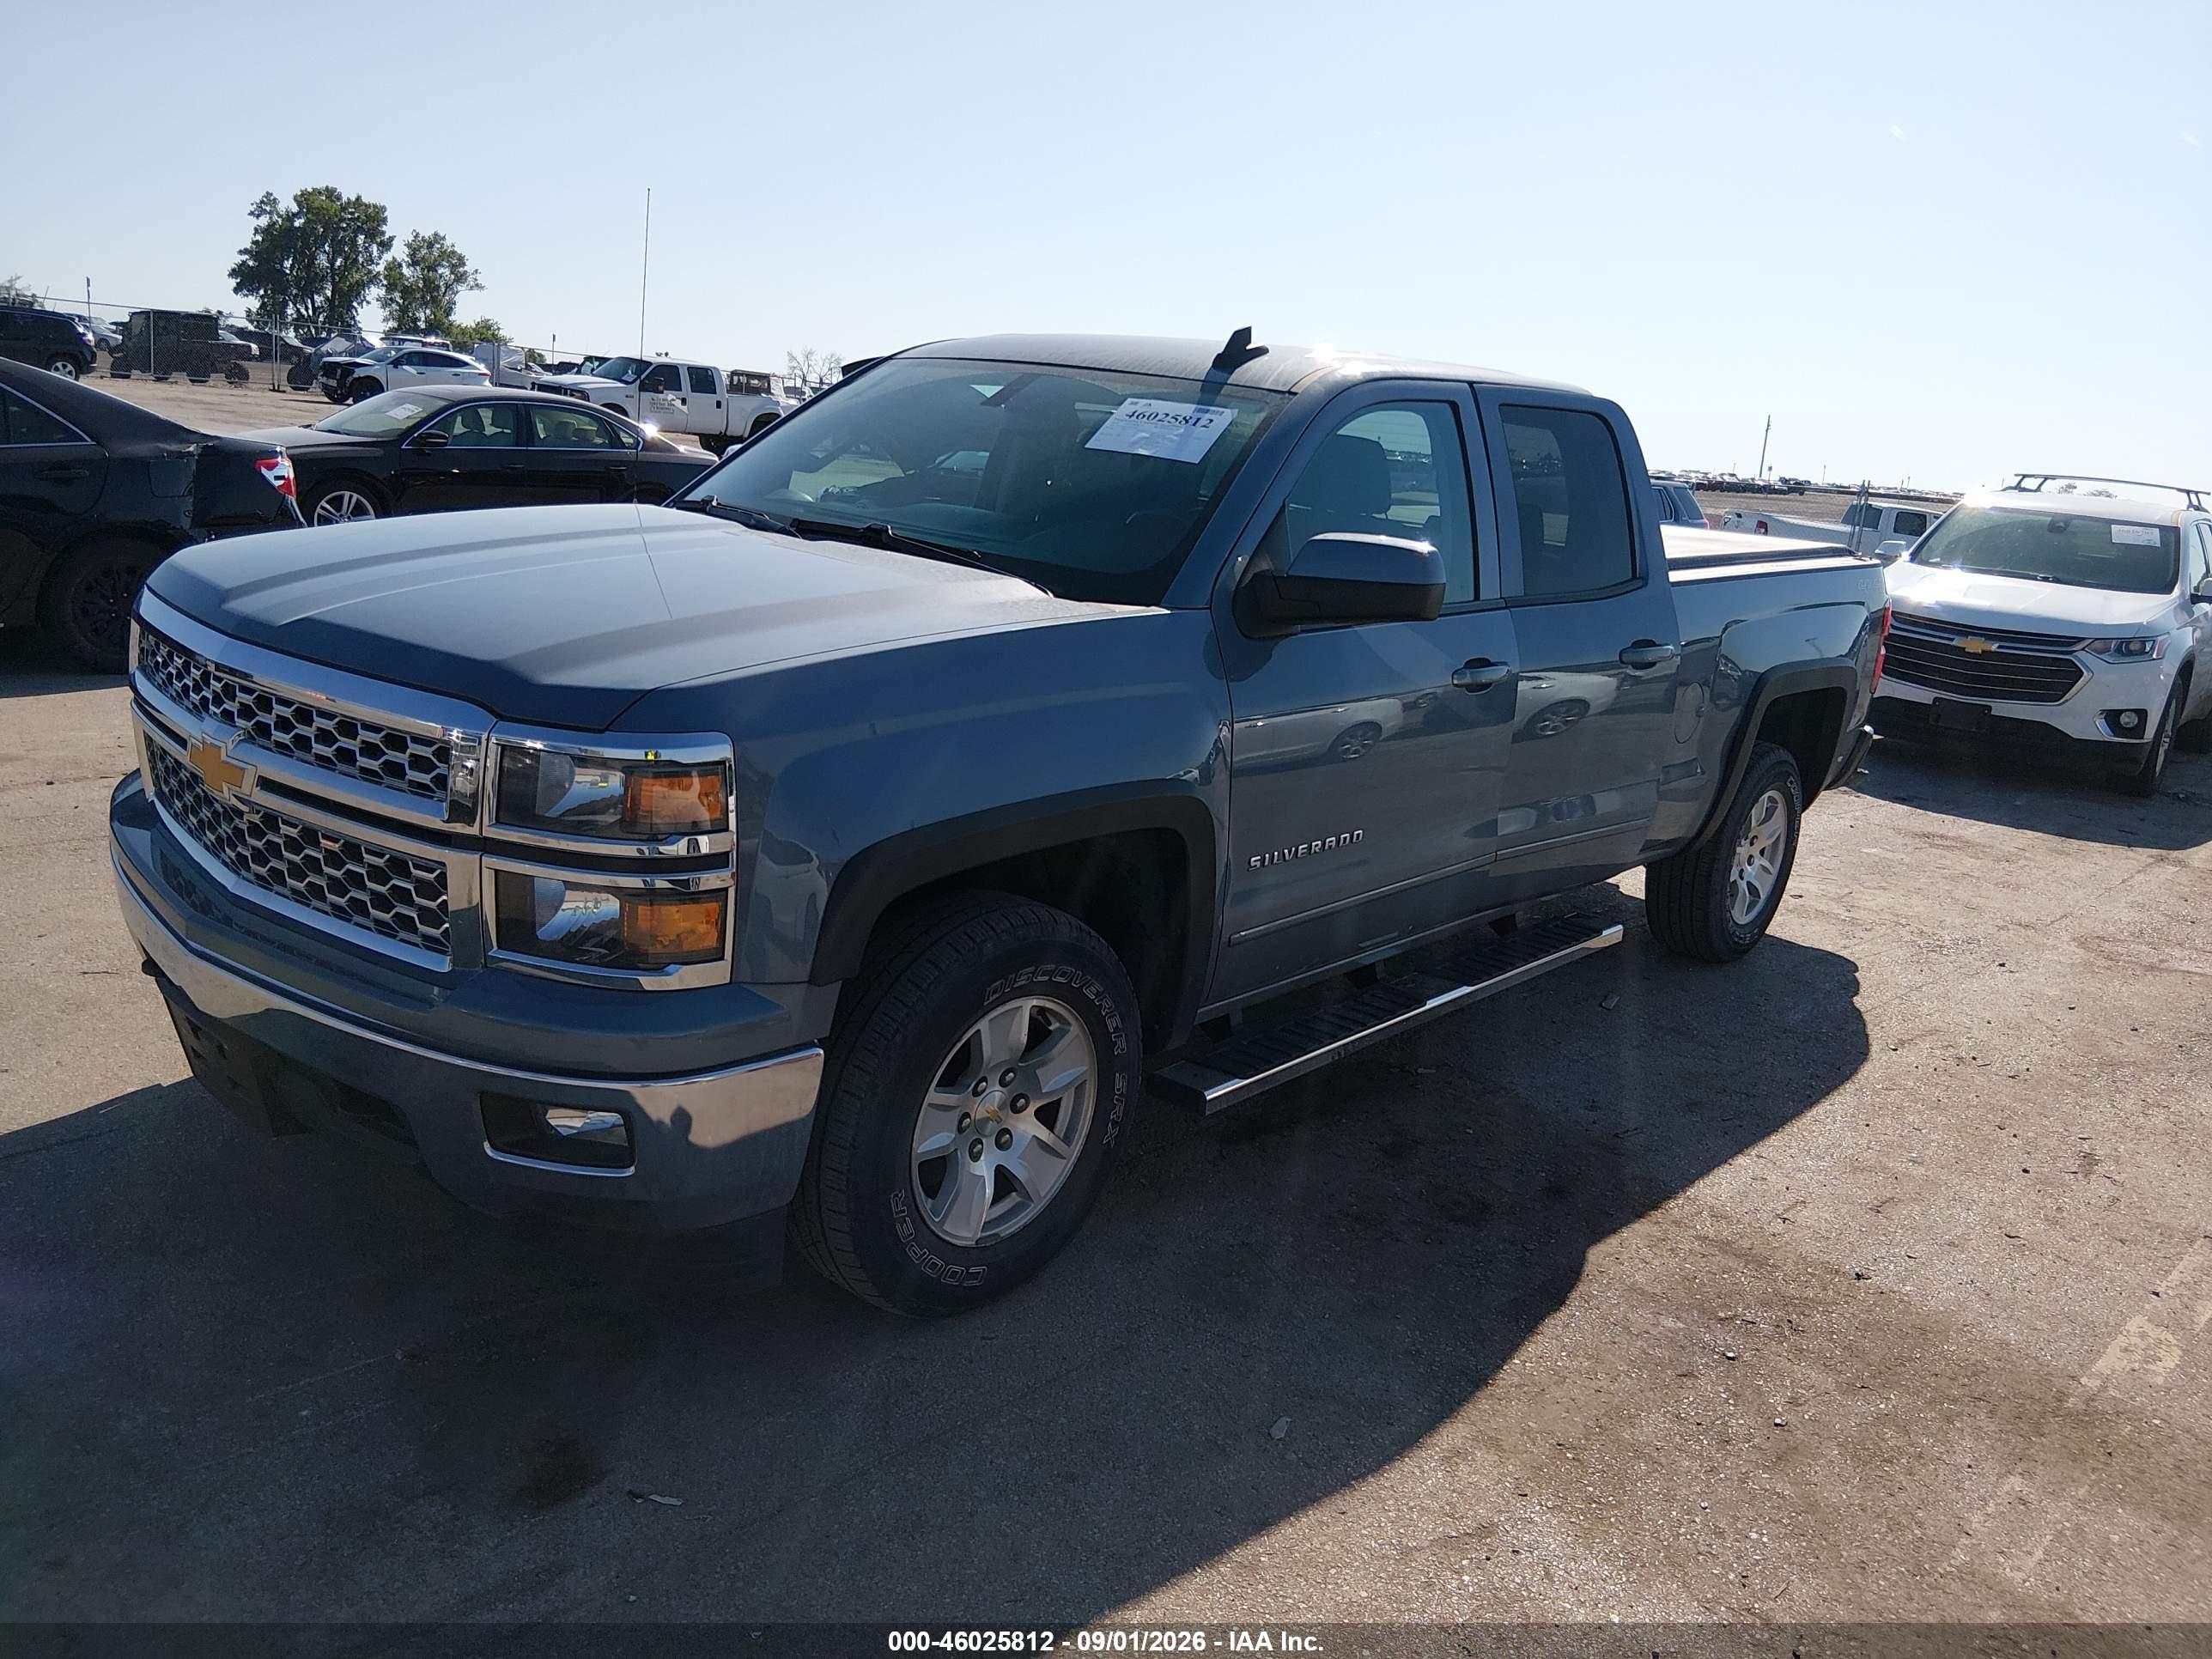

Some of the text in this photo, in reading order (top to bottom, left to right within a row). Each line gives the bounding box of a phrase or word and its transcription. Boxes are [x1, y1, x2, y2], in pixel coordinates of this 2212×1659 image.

[1126, 409, 1214, 428] 46025812
[1248, 829, 1364, 872] SILVERADO
[983, 964, 1127, 1148] DISCOVERER SRX
[890, 1188, 988, 1286] COOPER
